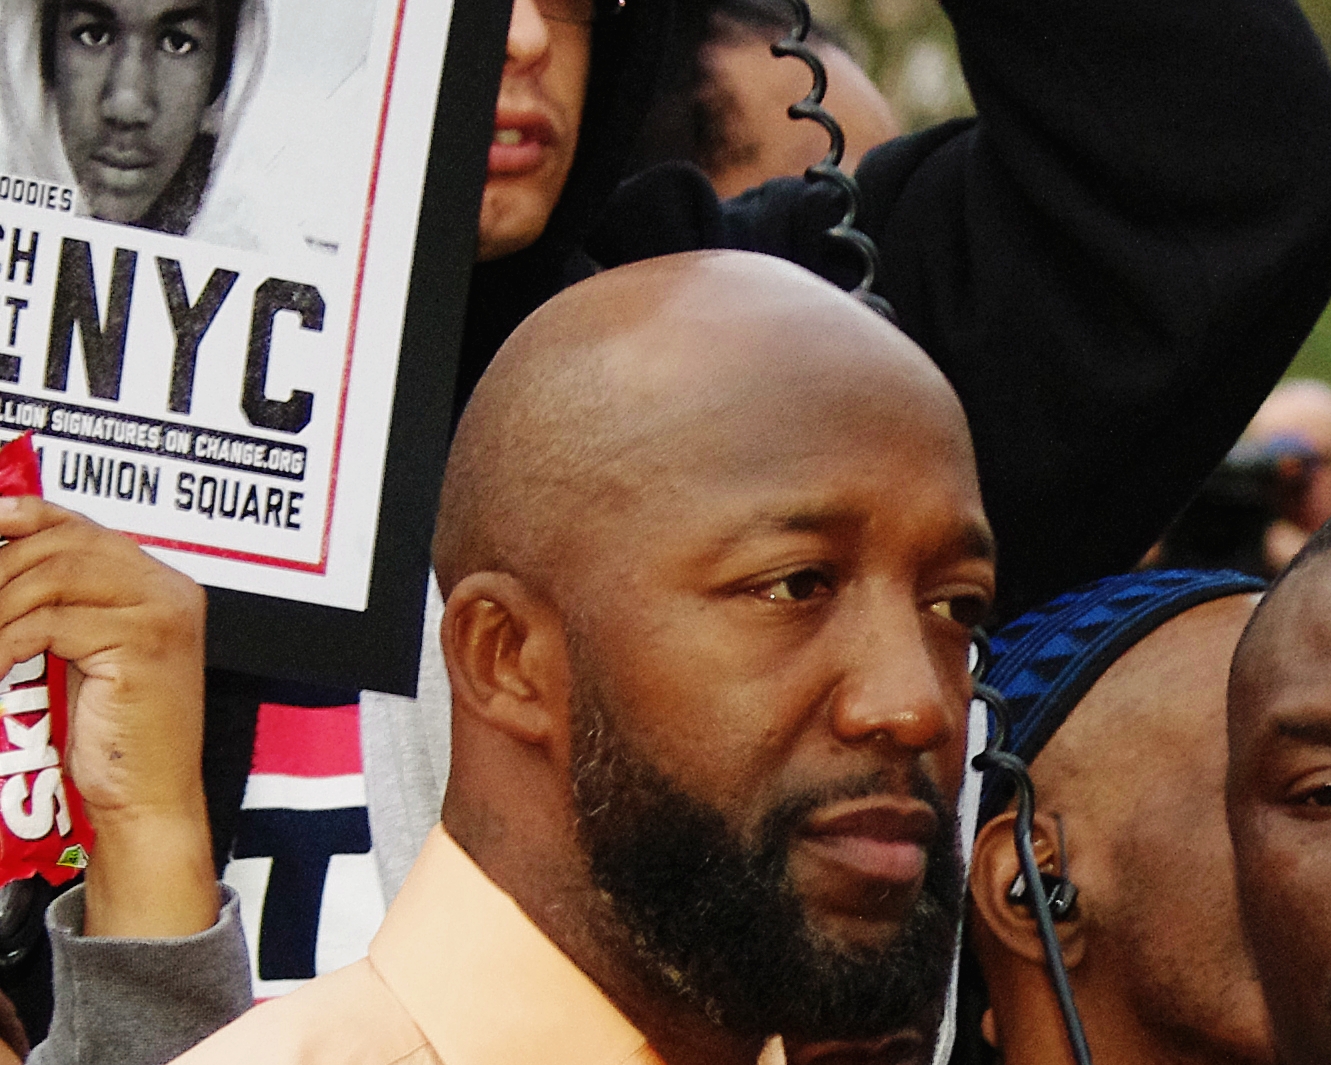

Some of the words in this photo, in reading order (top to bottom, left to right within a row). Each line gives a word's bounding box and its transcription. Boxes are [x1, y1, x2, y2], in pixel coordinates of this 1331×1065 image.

[0, 225, 39, 285] H
[43, 236, 326, 435] NYC
[51, 409, 162, 449] SIGNATURES
[165, 430, 193, 456] ON
[195, 435, 305, 474] CHANGE.ORG
[59, 451, 161, 506] UNION
[175, 471, 305, 531] SQUARE
